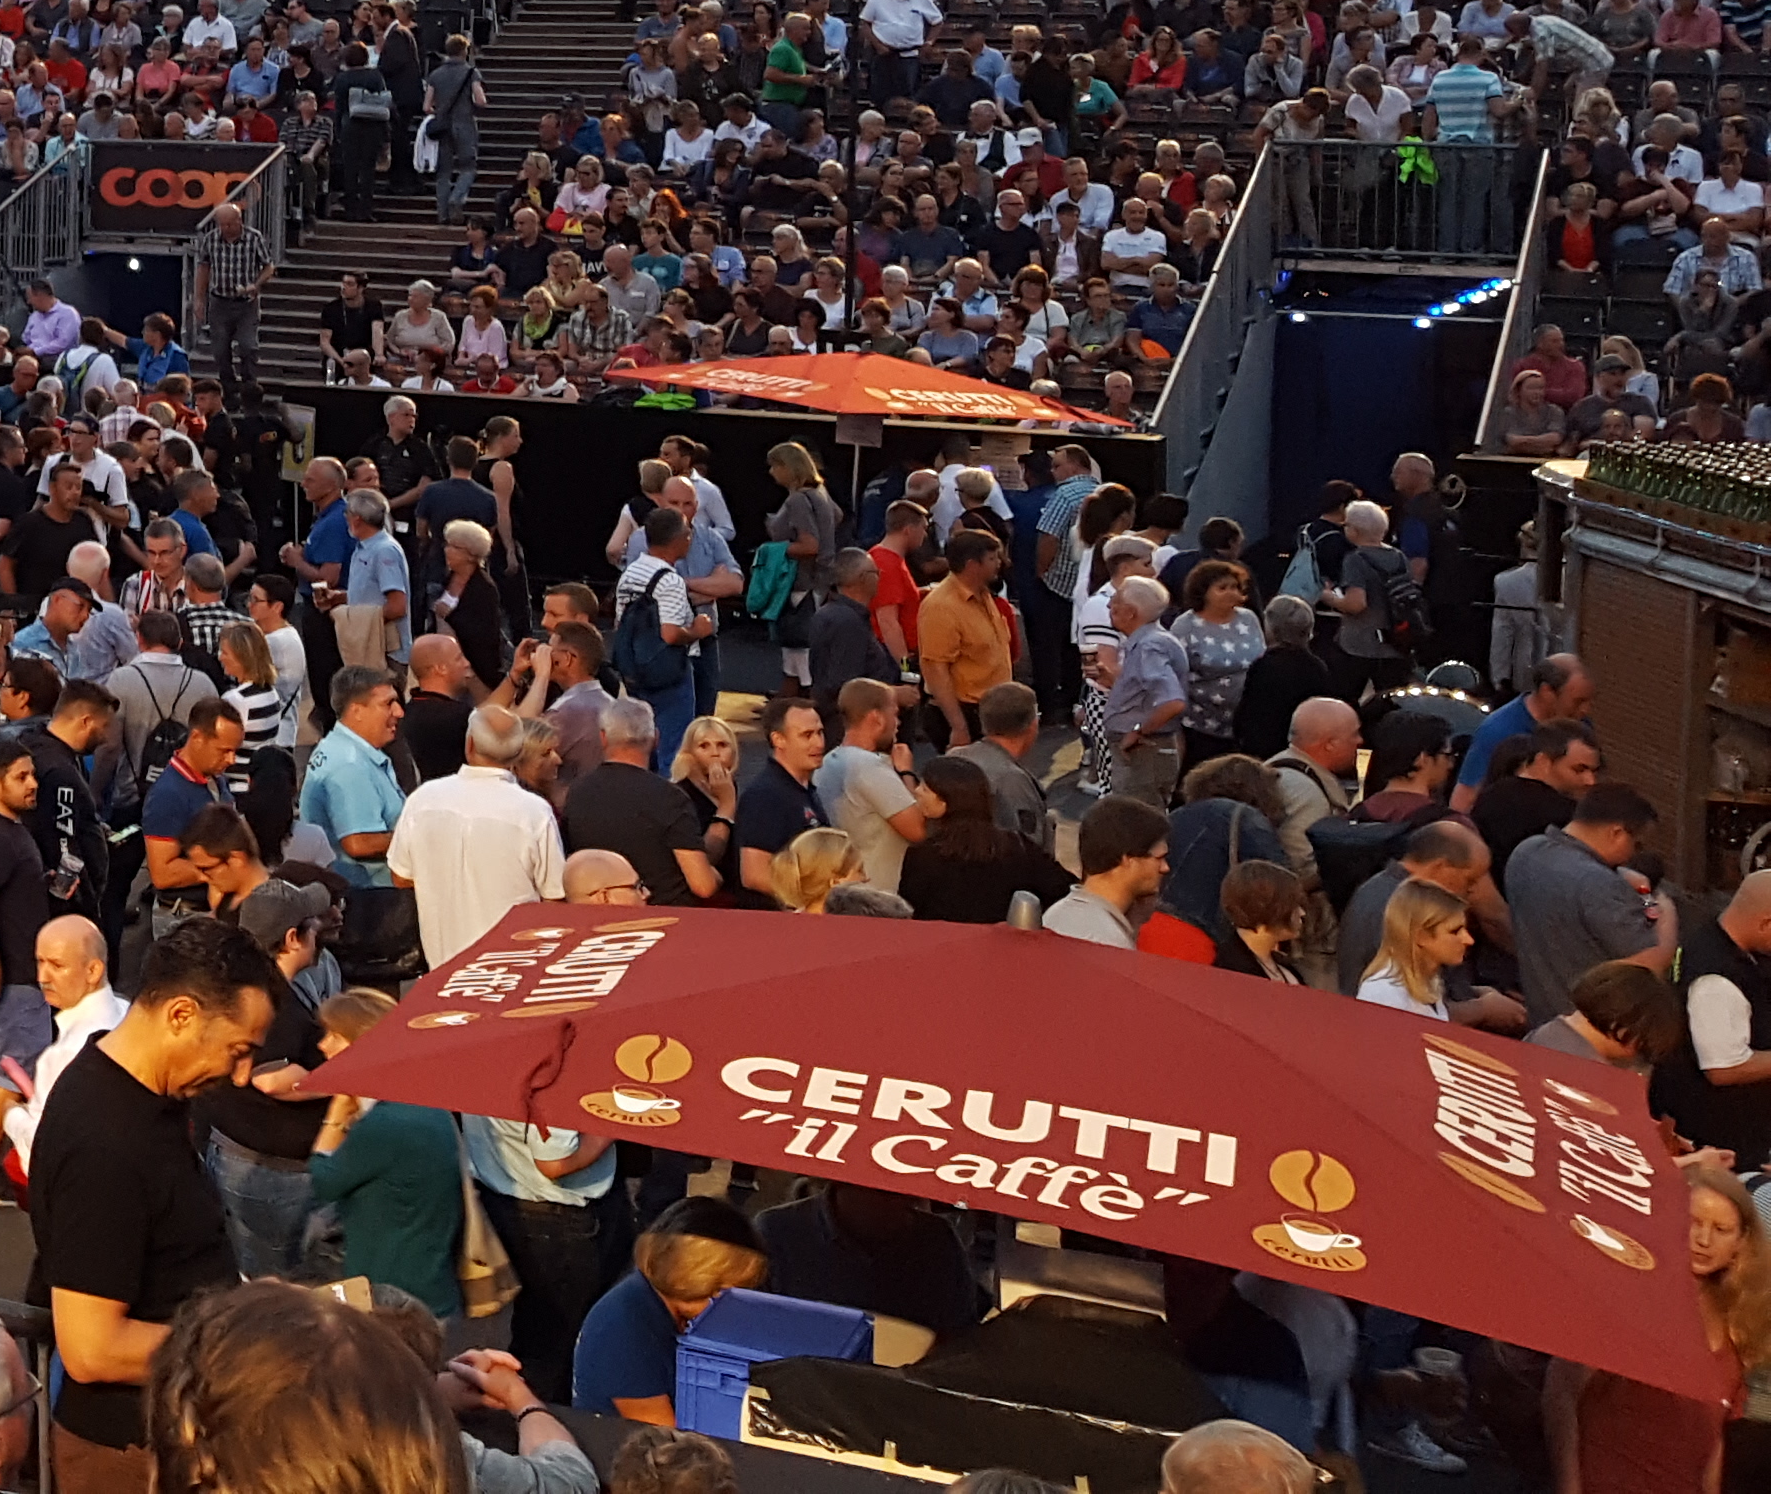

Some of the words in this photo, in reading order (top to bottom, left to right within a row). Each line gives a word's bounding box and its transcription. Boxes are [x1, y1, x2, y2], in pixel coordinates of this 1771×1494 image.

[889, 387, 1017, 406] CERUTTI
[56, 786, 75, 837] EA7
[522, 930, 666, 1003] CERUTTI
[721, 1056, 1238, 1188] CERUTTI
[1424, 1047, 1538, 1178] CERUTTI
